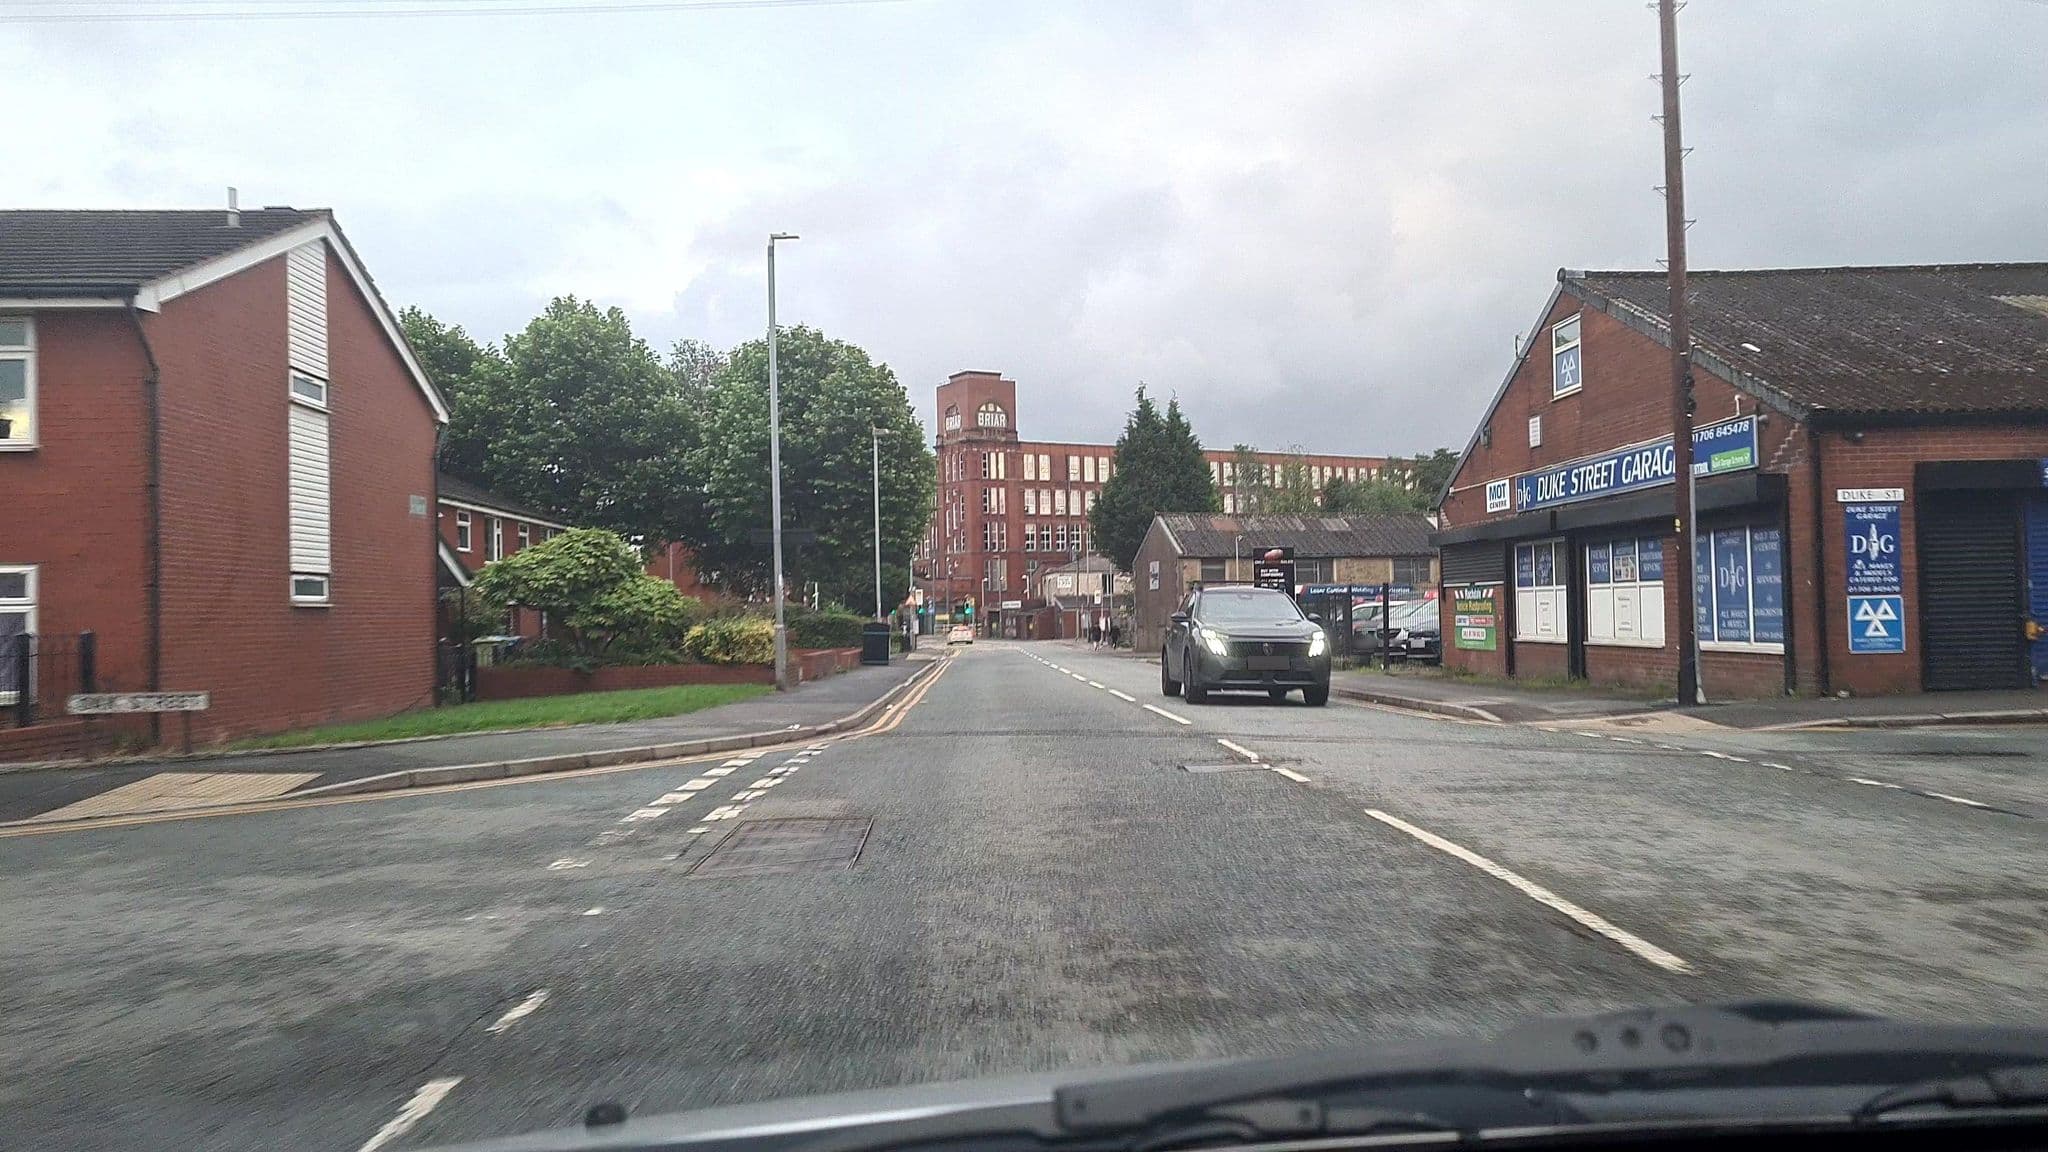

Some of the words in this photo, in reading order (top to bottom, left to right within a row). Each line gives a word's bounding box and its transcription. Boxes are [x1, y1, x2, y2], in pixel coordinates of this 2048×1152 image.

[945, 414, 962, 431] BRIAR
[977, 412, 1007, 428] BRIAR
[1715, 420, 1749, 438] 845478
[1537, 470, 1567, 502] DUKE
[1570, 458, 1618, 495] STREET
[1621, 445, 1676, 485] GARAG
[1489, 482, 1507, 502] MOT
[1842, 490, 1873, 500] DUKE
[1885, 489, 1900, 500] ST
[1489, 499, 1507, 510] CENTRE
[1869, 505, 1898, 513] STREET
